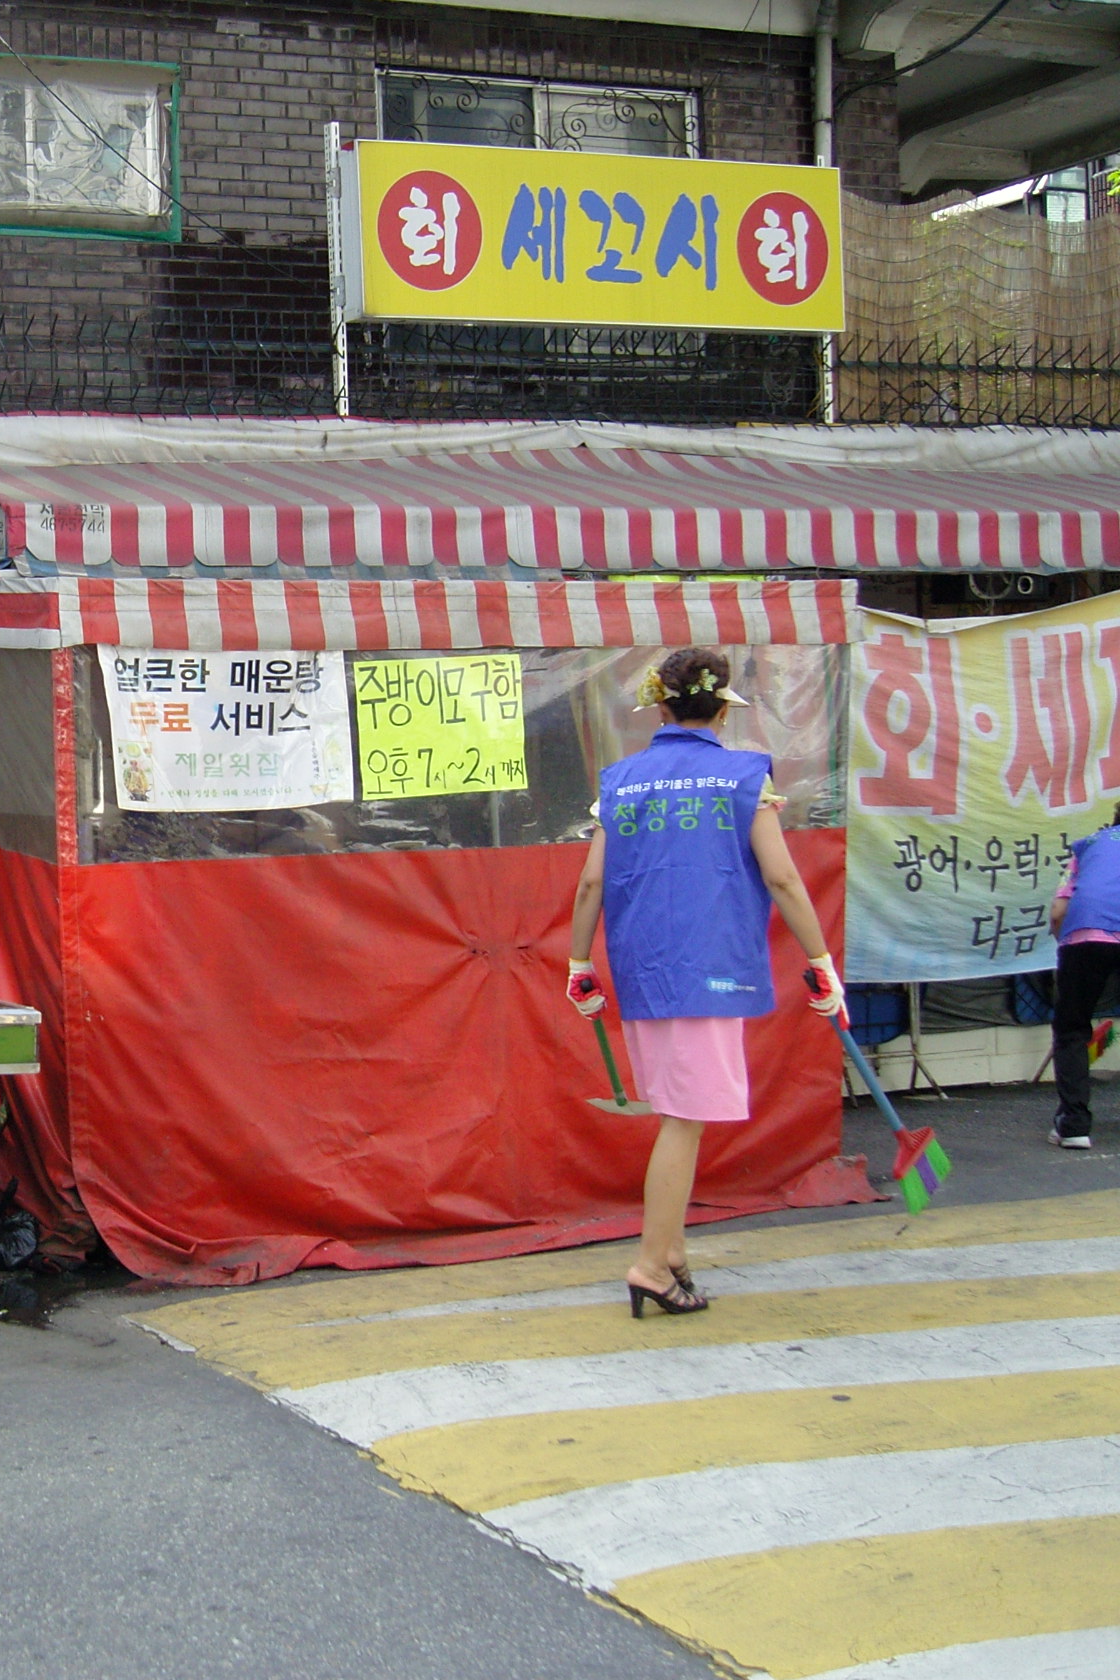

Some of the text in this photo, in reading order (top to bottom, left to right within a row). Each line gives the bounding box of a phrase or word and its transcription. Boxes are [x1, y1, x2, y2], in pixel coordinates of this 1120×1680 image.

[398, 183, 808, 291] 회 세꼬시 회
[114, 657, 324, 694] 얼큰한 매운탕
[129, 701, 311, 736] 무료 서비스
[175, 752, 278, 778] 제일횟집
[613, 797, 736, 836] 청정광진
